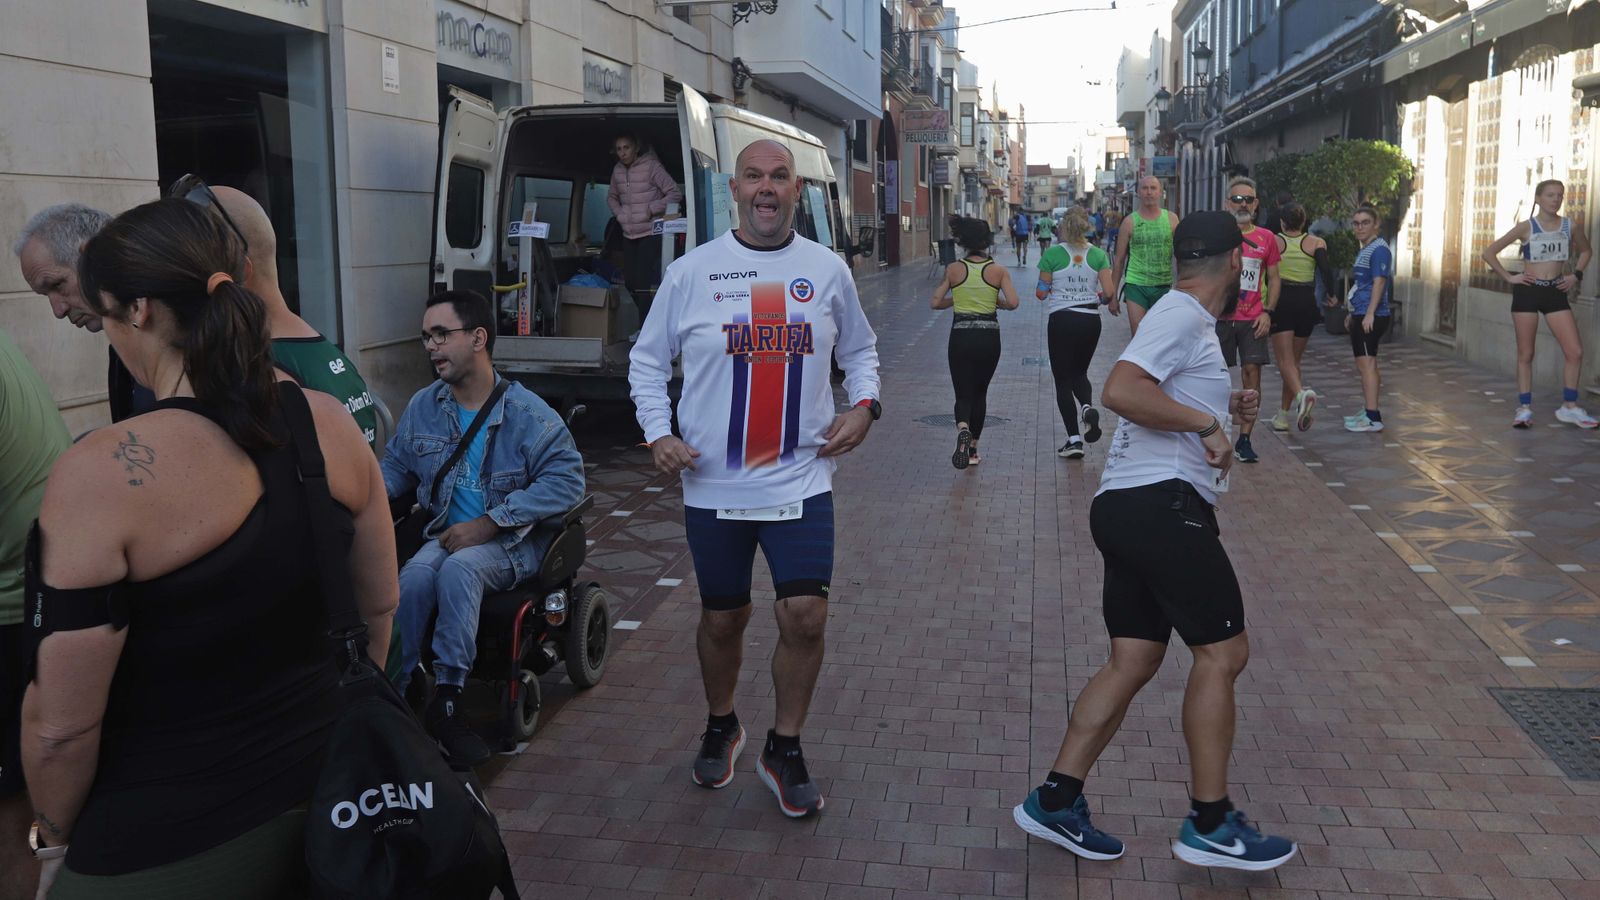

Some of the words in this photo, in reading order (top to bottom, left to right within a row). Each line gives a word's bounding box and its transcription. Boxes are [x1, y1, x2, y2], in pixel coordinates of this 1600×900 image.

[1541, 242, 1562, 254] 201
[709, 271, 758, 281] GIVOVA
[1241, 269, 1256, 281] 98
[721, 322, 815, 355] TARIFA
[330, 781, 434, 829] OCEAN
[373, 819, 402, 834] HEALTH
